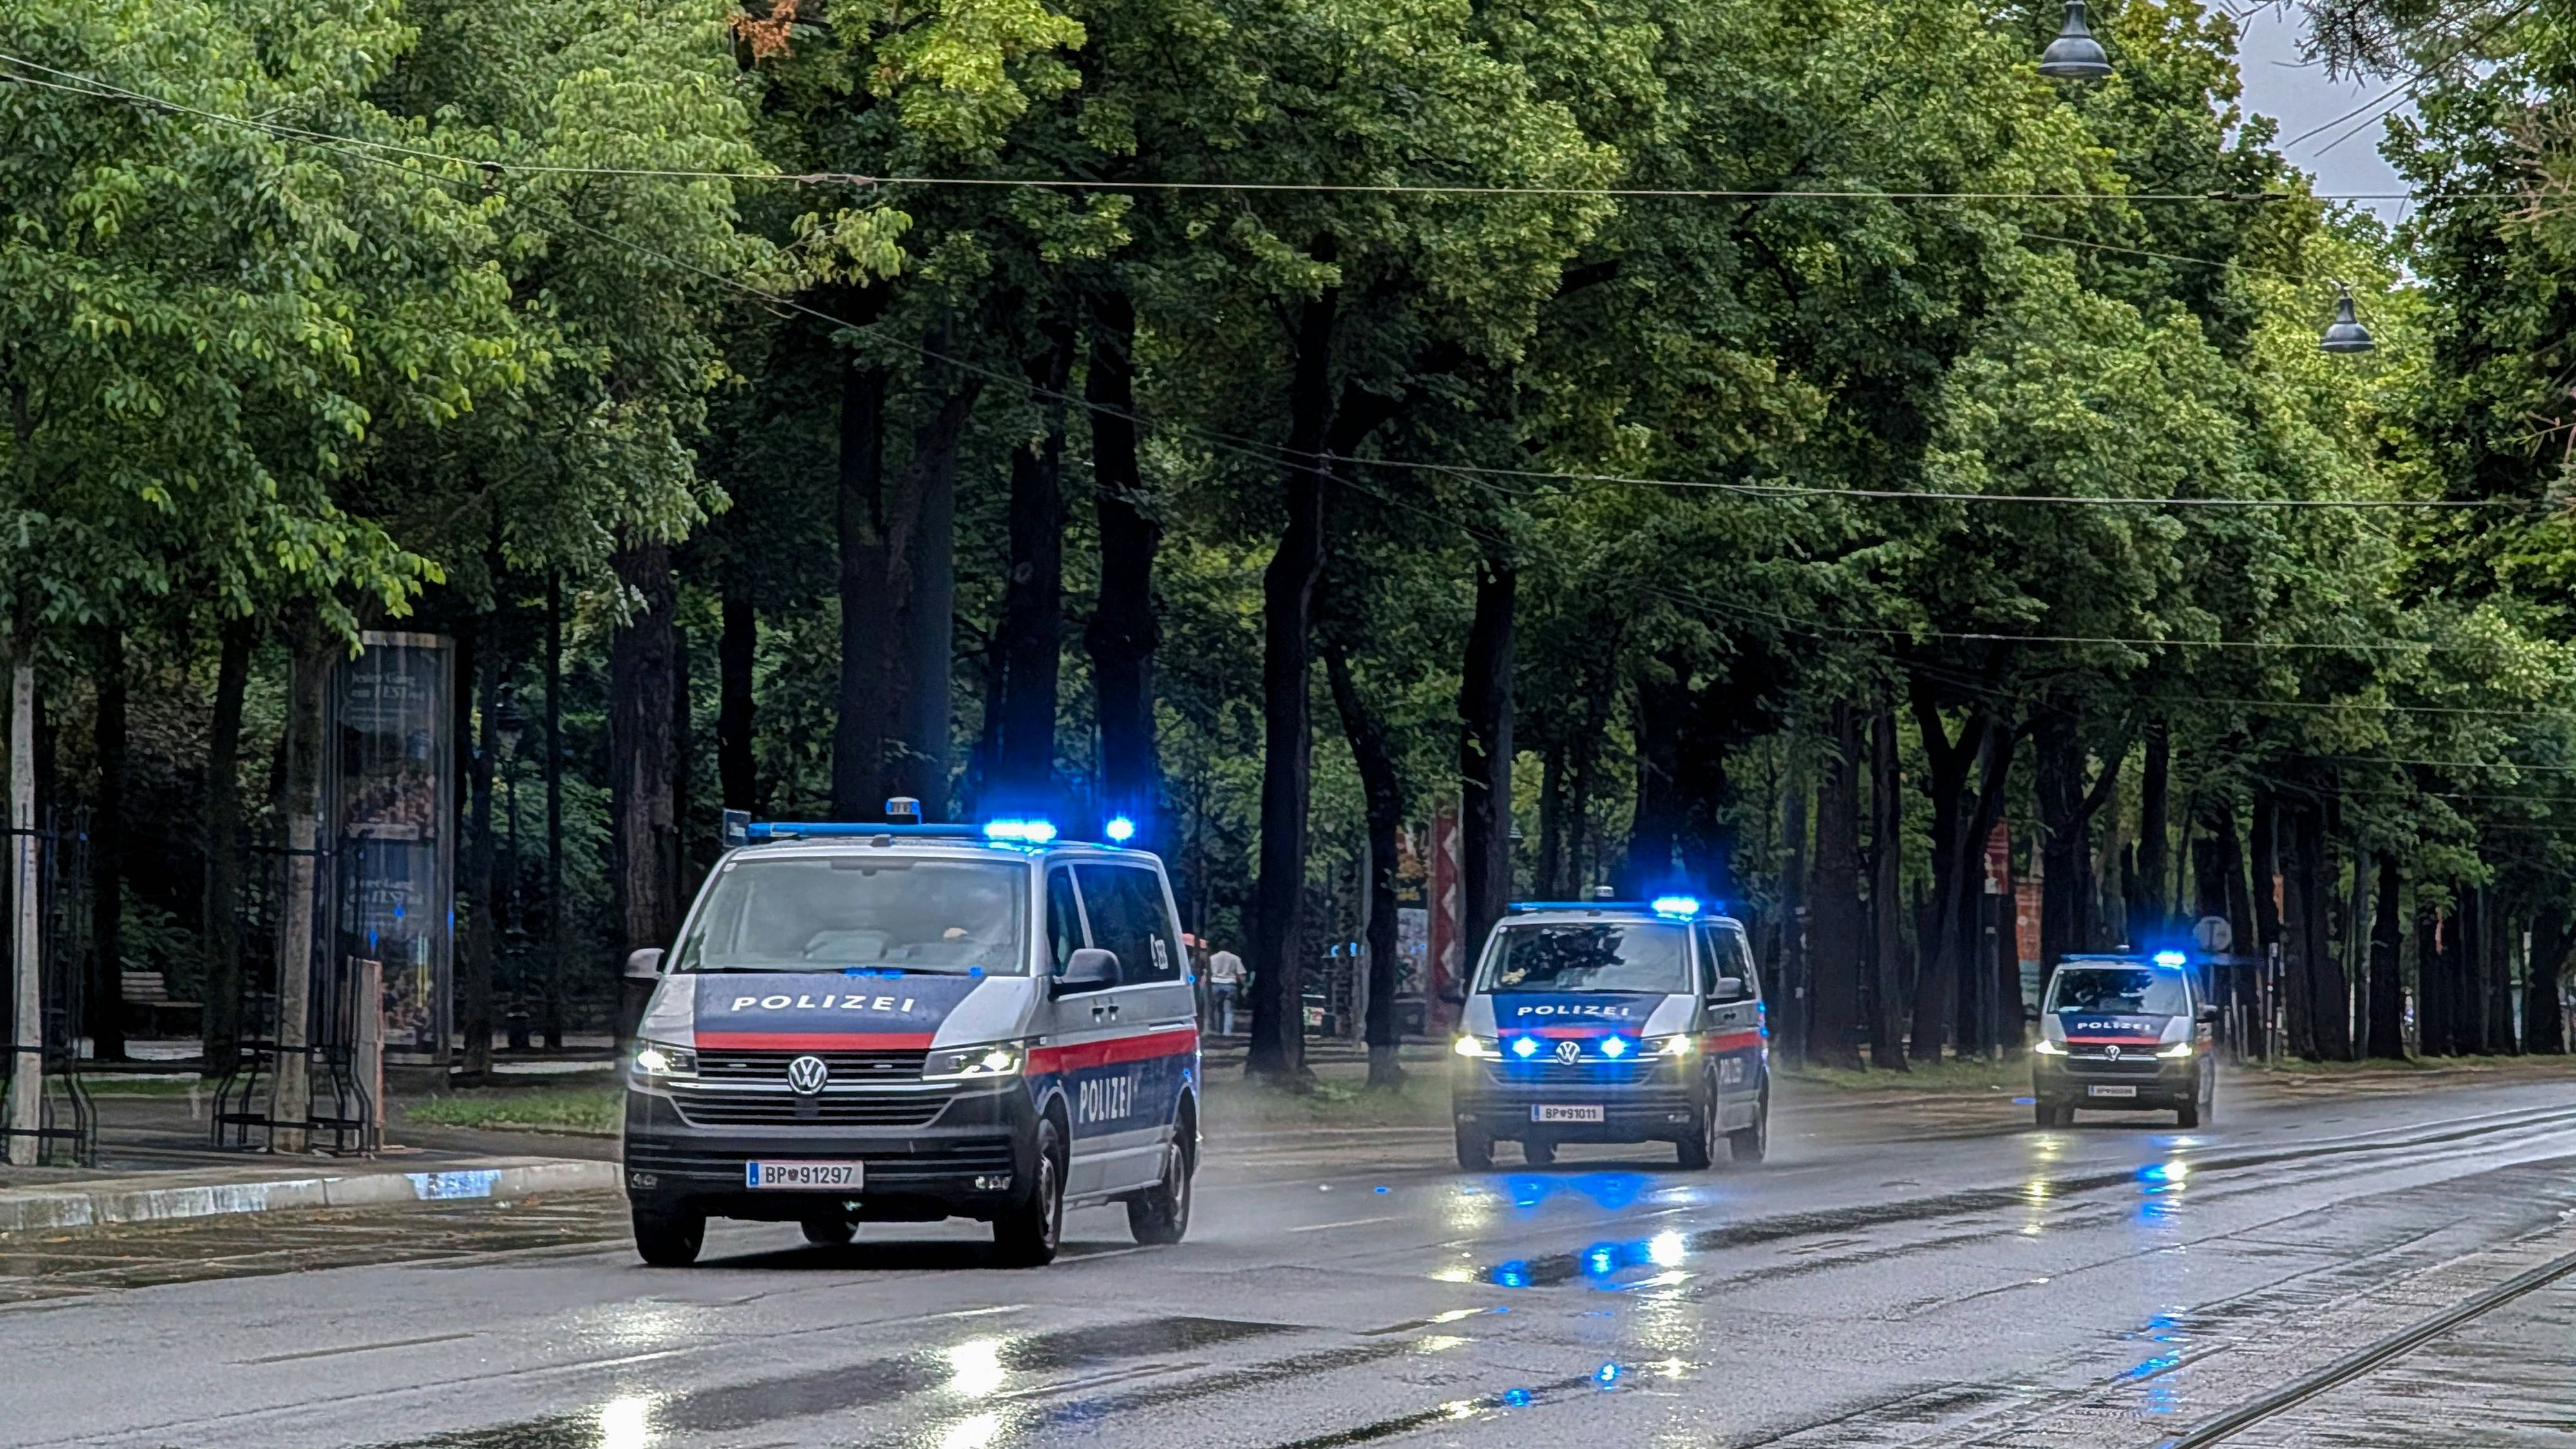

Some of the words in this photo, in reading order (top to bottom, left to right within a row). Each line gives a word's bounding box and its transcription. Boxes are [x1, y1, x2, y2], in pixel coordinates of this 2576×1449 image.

[731, 995, 914, 1012] POLIZEI
[1517, 1005, 1630, 1016] POLIZEI
[2077, 1021, 2150, 1030] POLIZEI
[1556, 1041, 1581, 1065] VW
[789, 1056, 828, 1094] VW
[1079, 1075, 1132, 1123] POLIZEI
